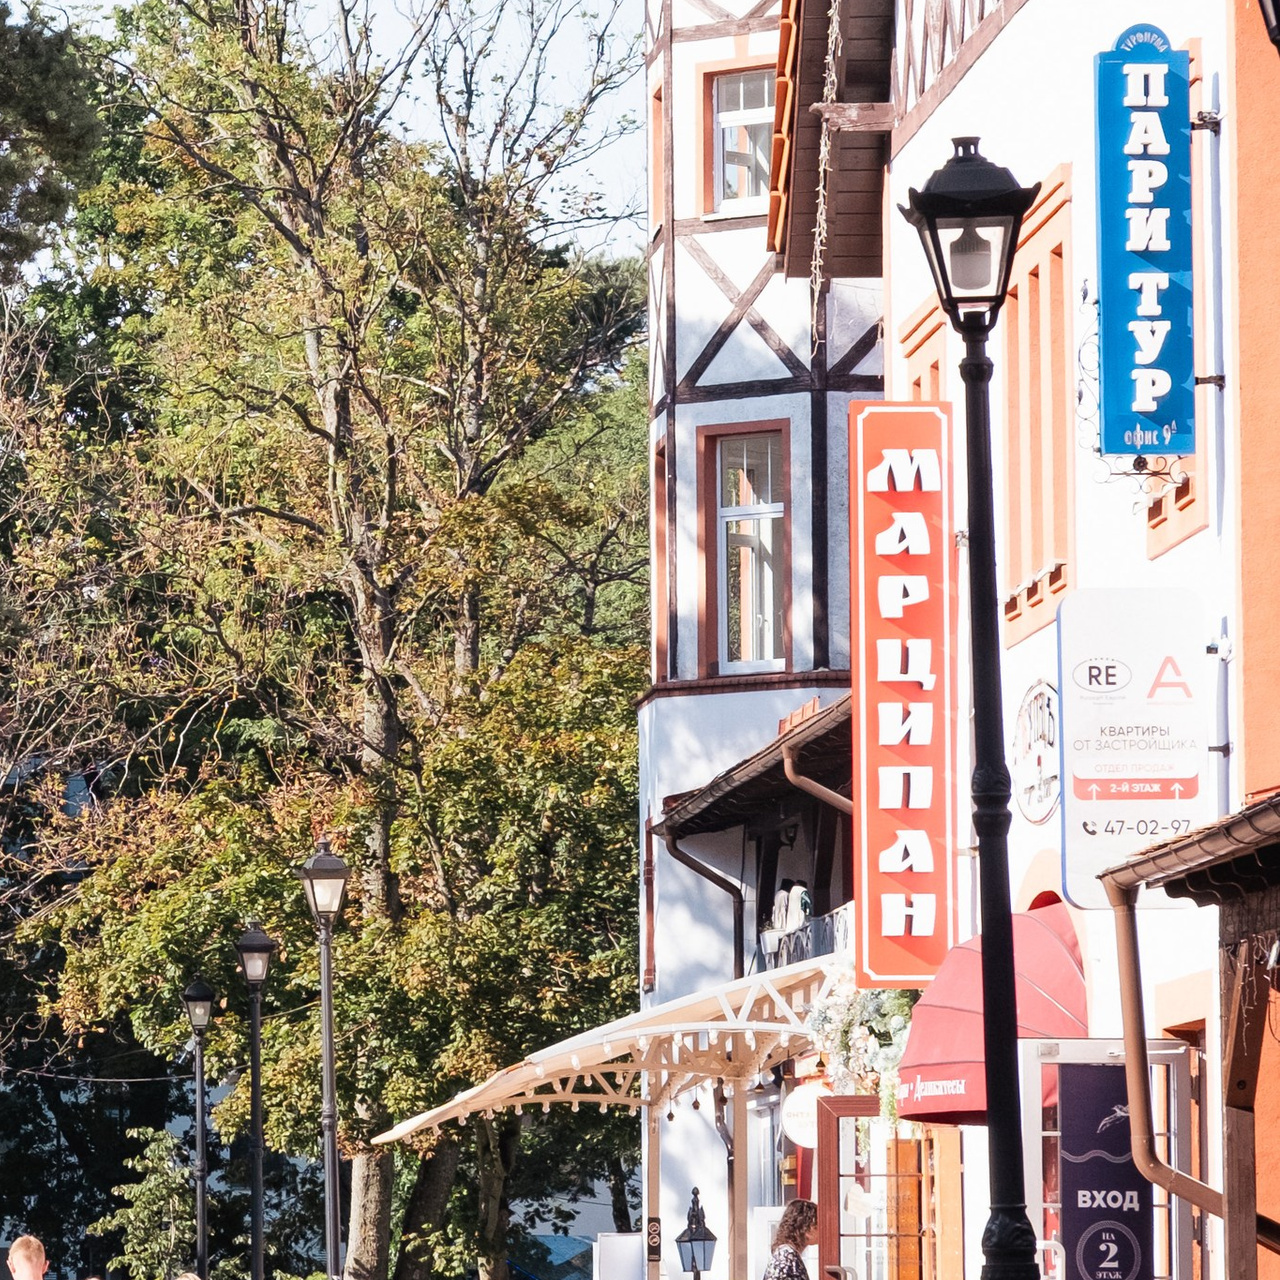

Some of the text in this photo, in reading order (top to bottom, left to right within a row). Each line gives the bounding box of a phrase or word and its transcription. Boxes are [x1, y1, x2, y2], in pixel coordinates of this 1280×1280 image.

[1120, 31, 1169, 53] ТУРФИРМА
[1122, 62, 1173, 413] ПАРИ ТУР
[1124, 422, 1159, 450] офис
[1087, 665, 1118, 686] RE
[867, 448, 942, 938] МАРЦИПАН
[1100, 725, 1170, 737] КВАРТИРЫ
[1073, 737, 1198, 751] ОТ ЗАСТРОЙЩИКА
[1094, 763, 1175, 773] ОТДЕЛ ПРОДАЖ
[1110, 782, 1162, 793] 2-Й ЭТАЖ
[1103, 819, 1192, 837] 47-02-97
[1077, 1189, 1140, 1212] ВХОД
[1102, 1231, 1116, 1241] НА
[1098, 1242, 1119, 1269] 2
[1095, 1271, 1123, 1280] ЭТАЖ
